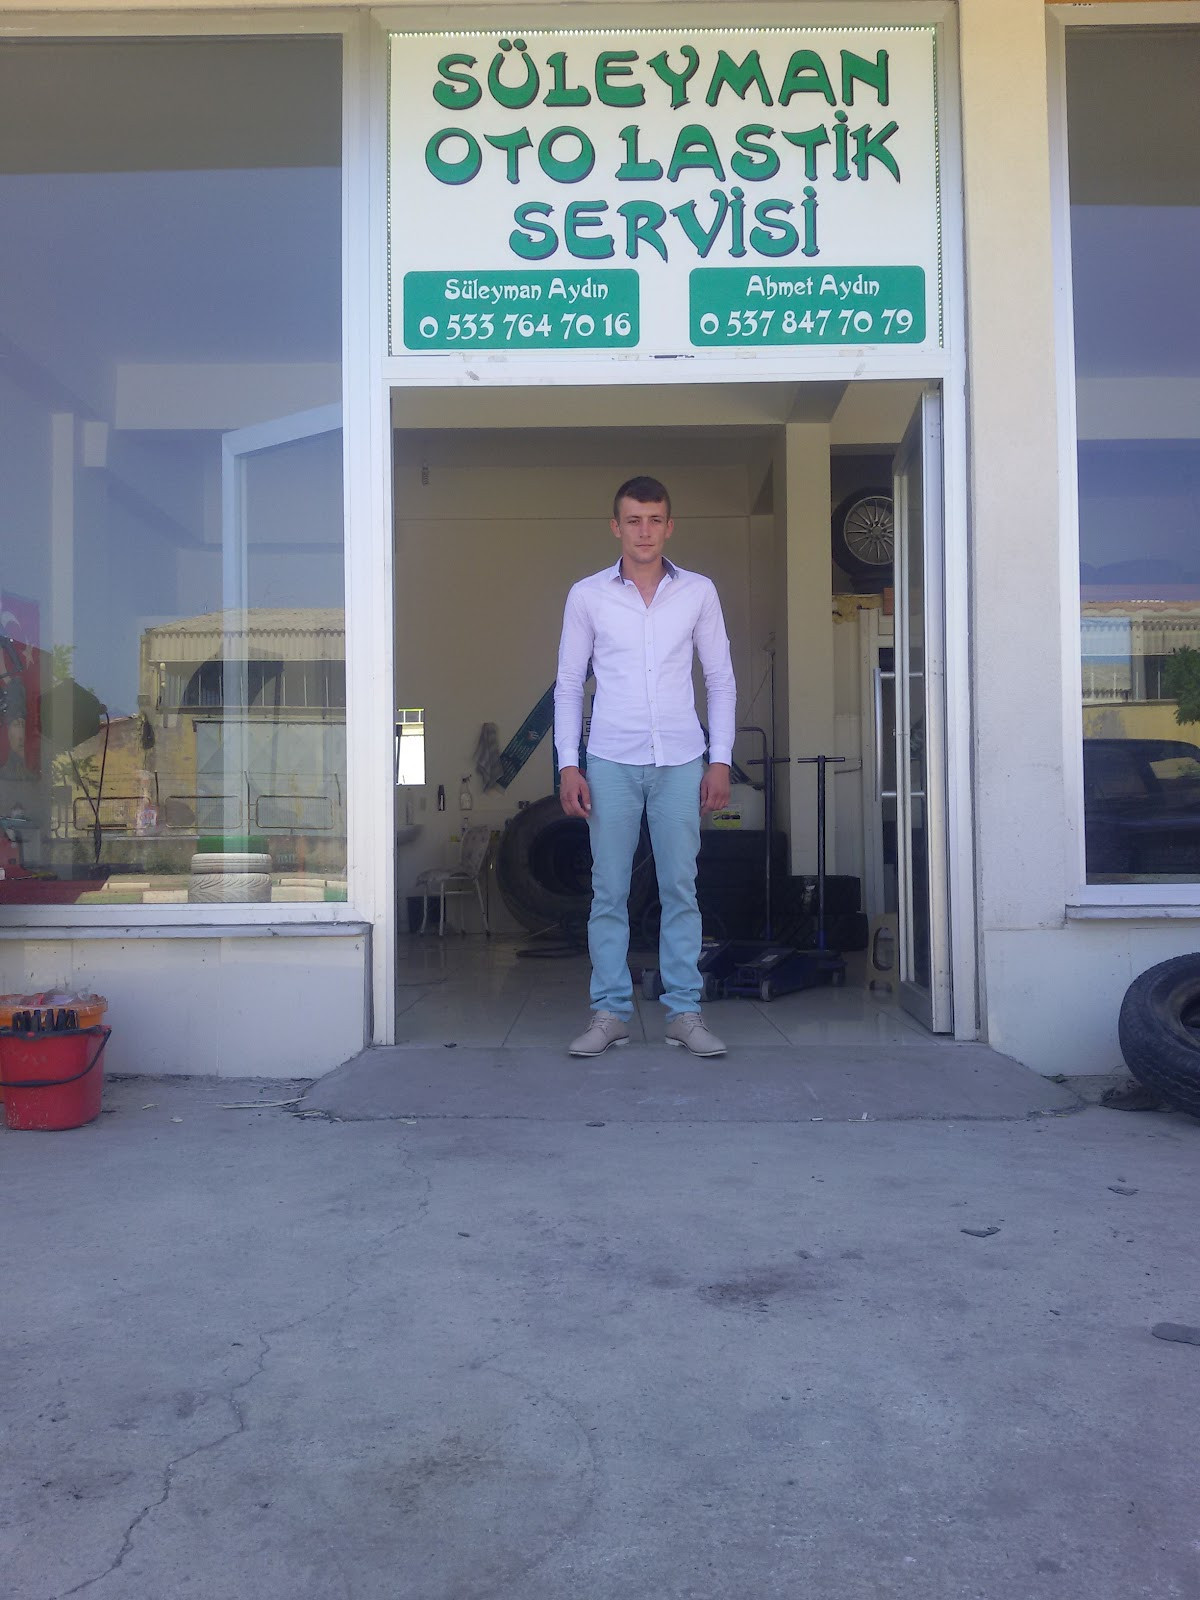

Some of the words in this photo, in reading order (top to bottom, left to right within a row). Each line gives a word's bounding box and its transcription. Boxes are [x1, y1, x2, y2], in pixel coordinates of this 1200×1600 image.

[432, 38, 890, 111] SÜLEYMAN
[424, 125, 596, 186] OTO
[614, 109, 901, 185] LASTİK
[508, 185, 821, 264] SERVİSİ
[444, 278, 542, 305] Süleyman
[548, 277, 609, 304] Aydın
[746, 274, 814, 300] Ahmet
[819, 273, 880, 300] Aydın
[446, 313, 495, 341] 533
[503, 312, 553, 341] 764
[560, 312, 595, 340] 70
[602, 312, 631, 337] 16
[726, 309, 776, 337] 537
[781, 309, 832, 337] 847
[838, 309, 873, 336] 70
[881, 308, 913, 335] 79
